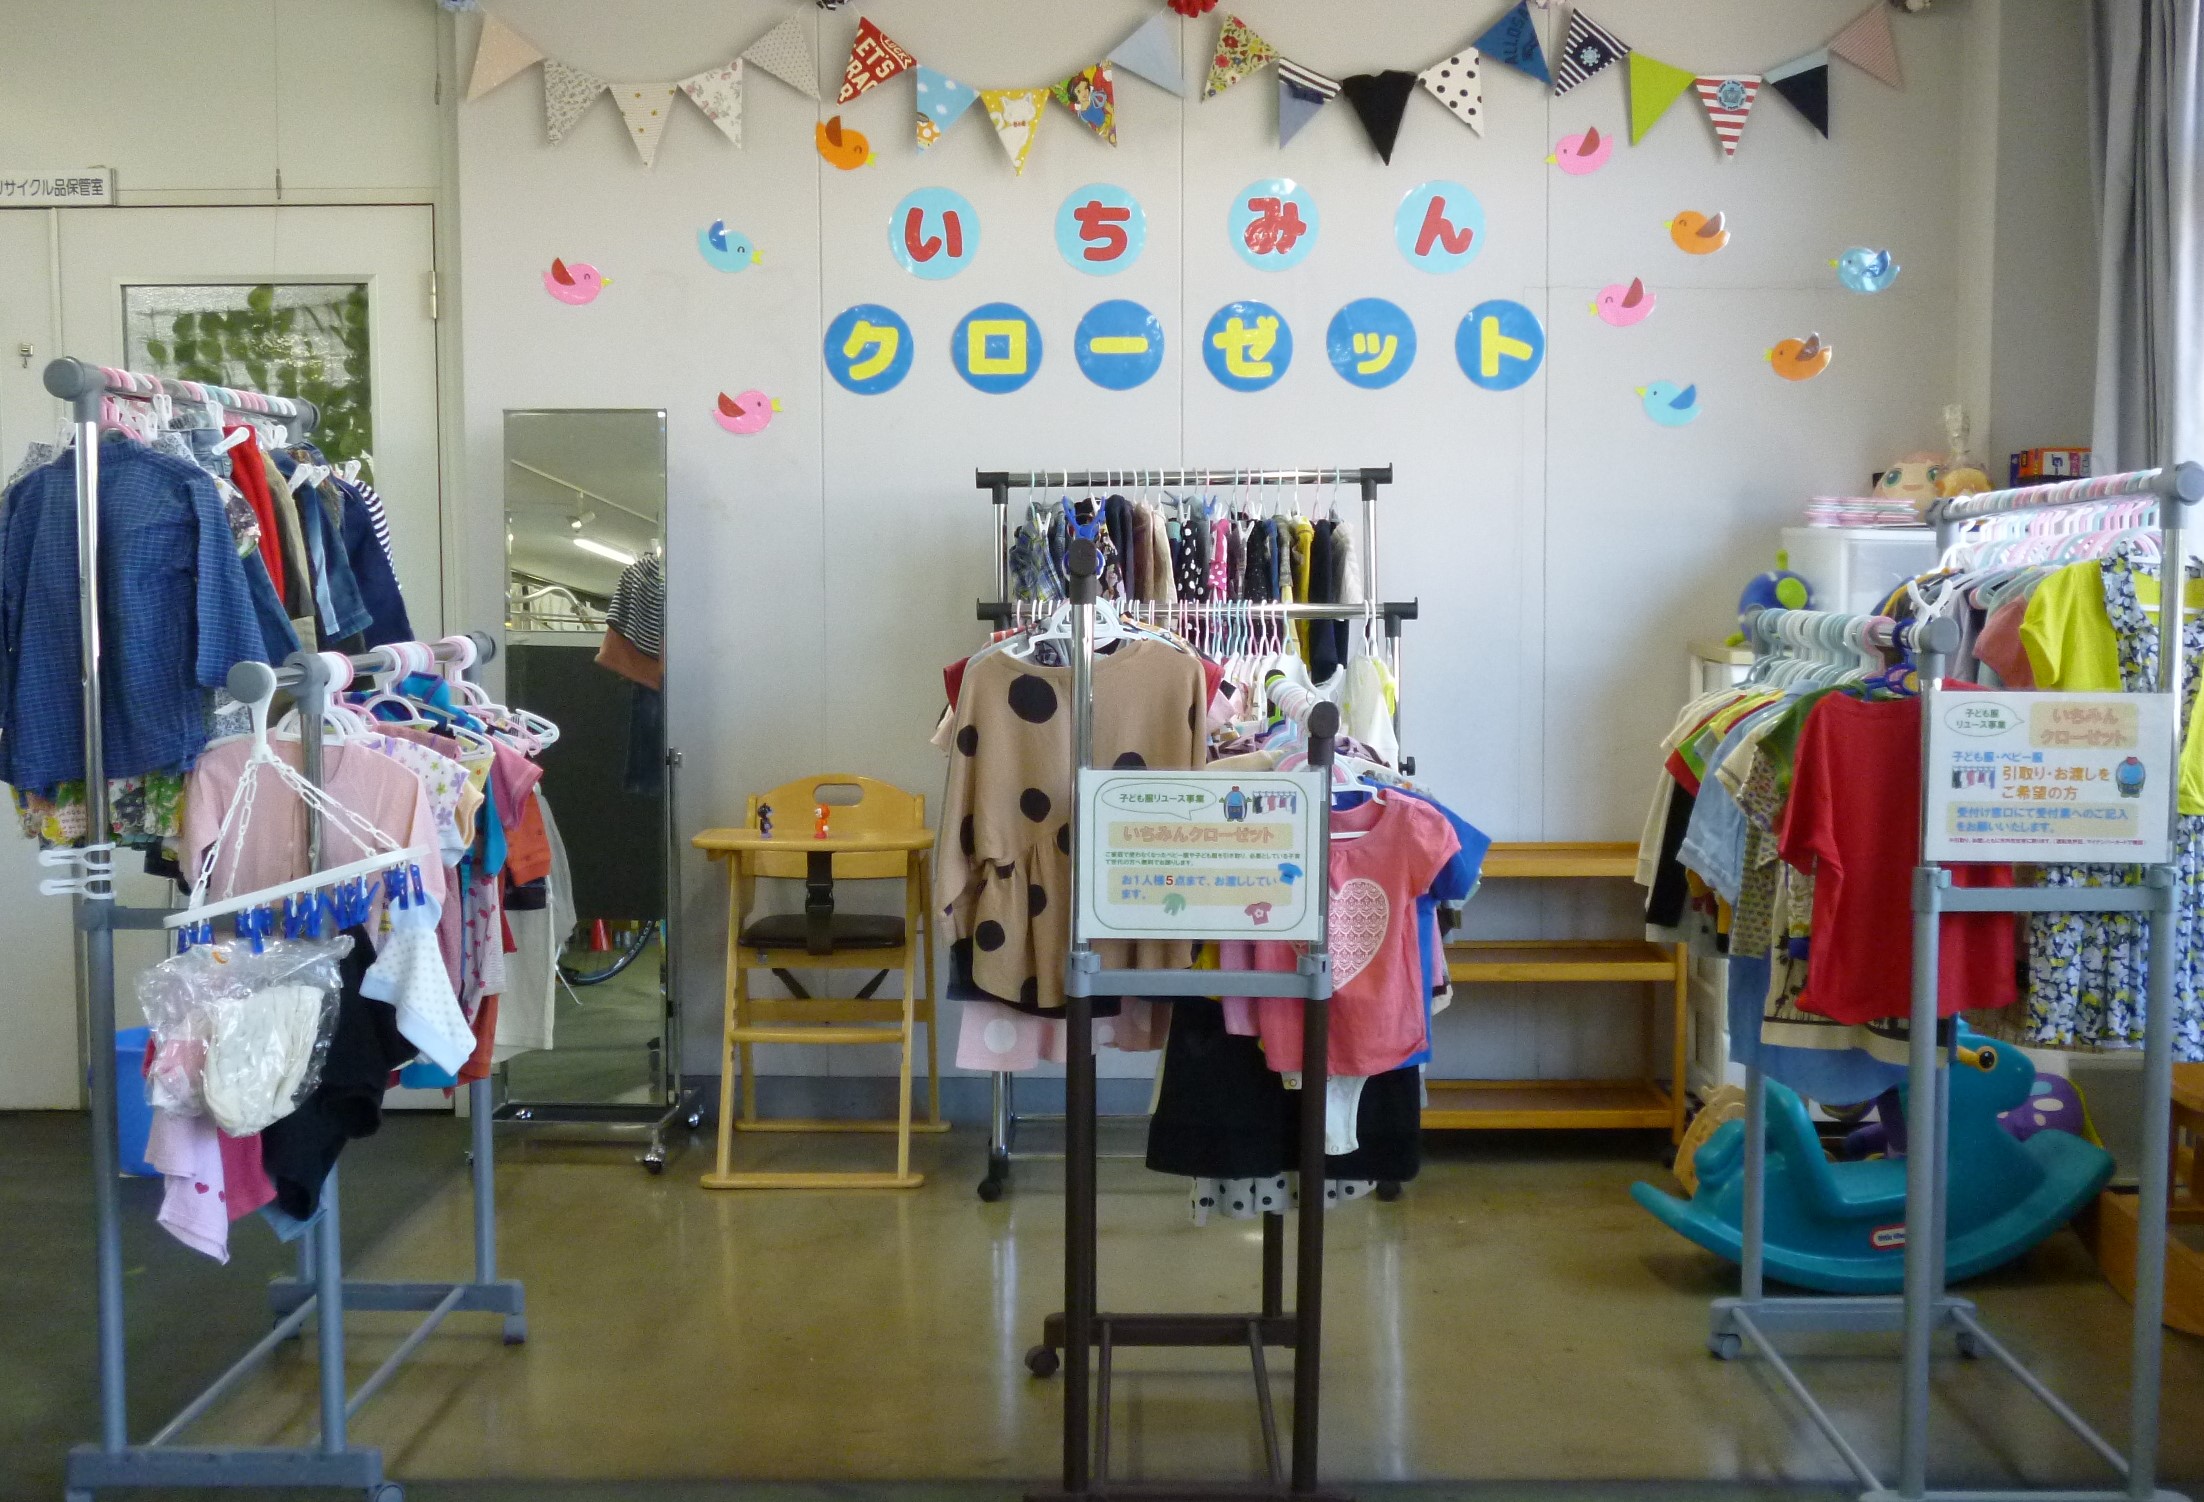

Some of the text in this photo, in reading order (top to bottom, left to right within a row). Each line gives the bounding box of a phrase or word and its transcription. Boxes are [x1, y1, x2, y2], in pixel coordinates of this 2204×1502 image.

[904, 194, 1474, 261] いちみん
[843, 315, 1534, 380] クローゼット
[1965, 708, 1999, 719] 子ども服
[2052, 708, 2119, 726] いちみん
[2040, 729, 2128, 746] クローゼット
[2002, 765, 2110, 782] 引取り・お渡しを
[2001, 785, 2079, 801] ご希望の方
[1123, 825, 1274, 843] いちみんクローゼット
[1121, 889, 1147, 900] ます。
